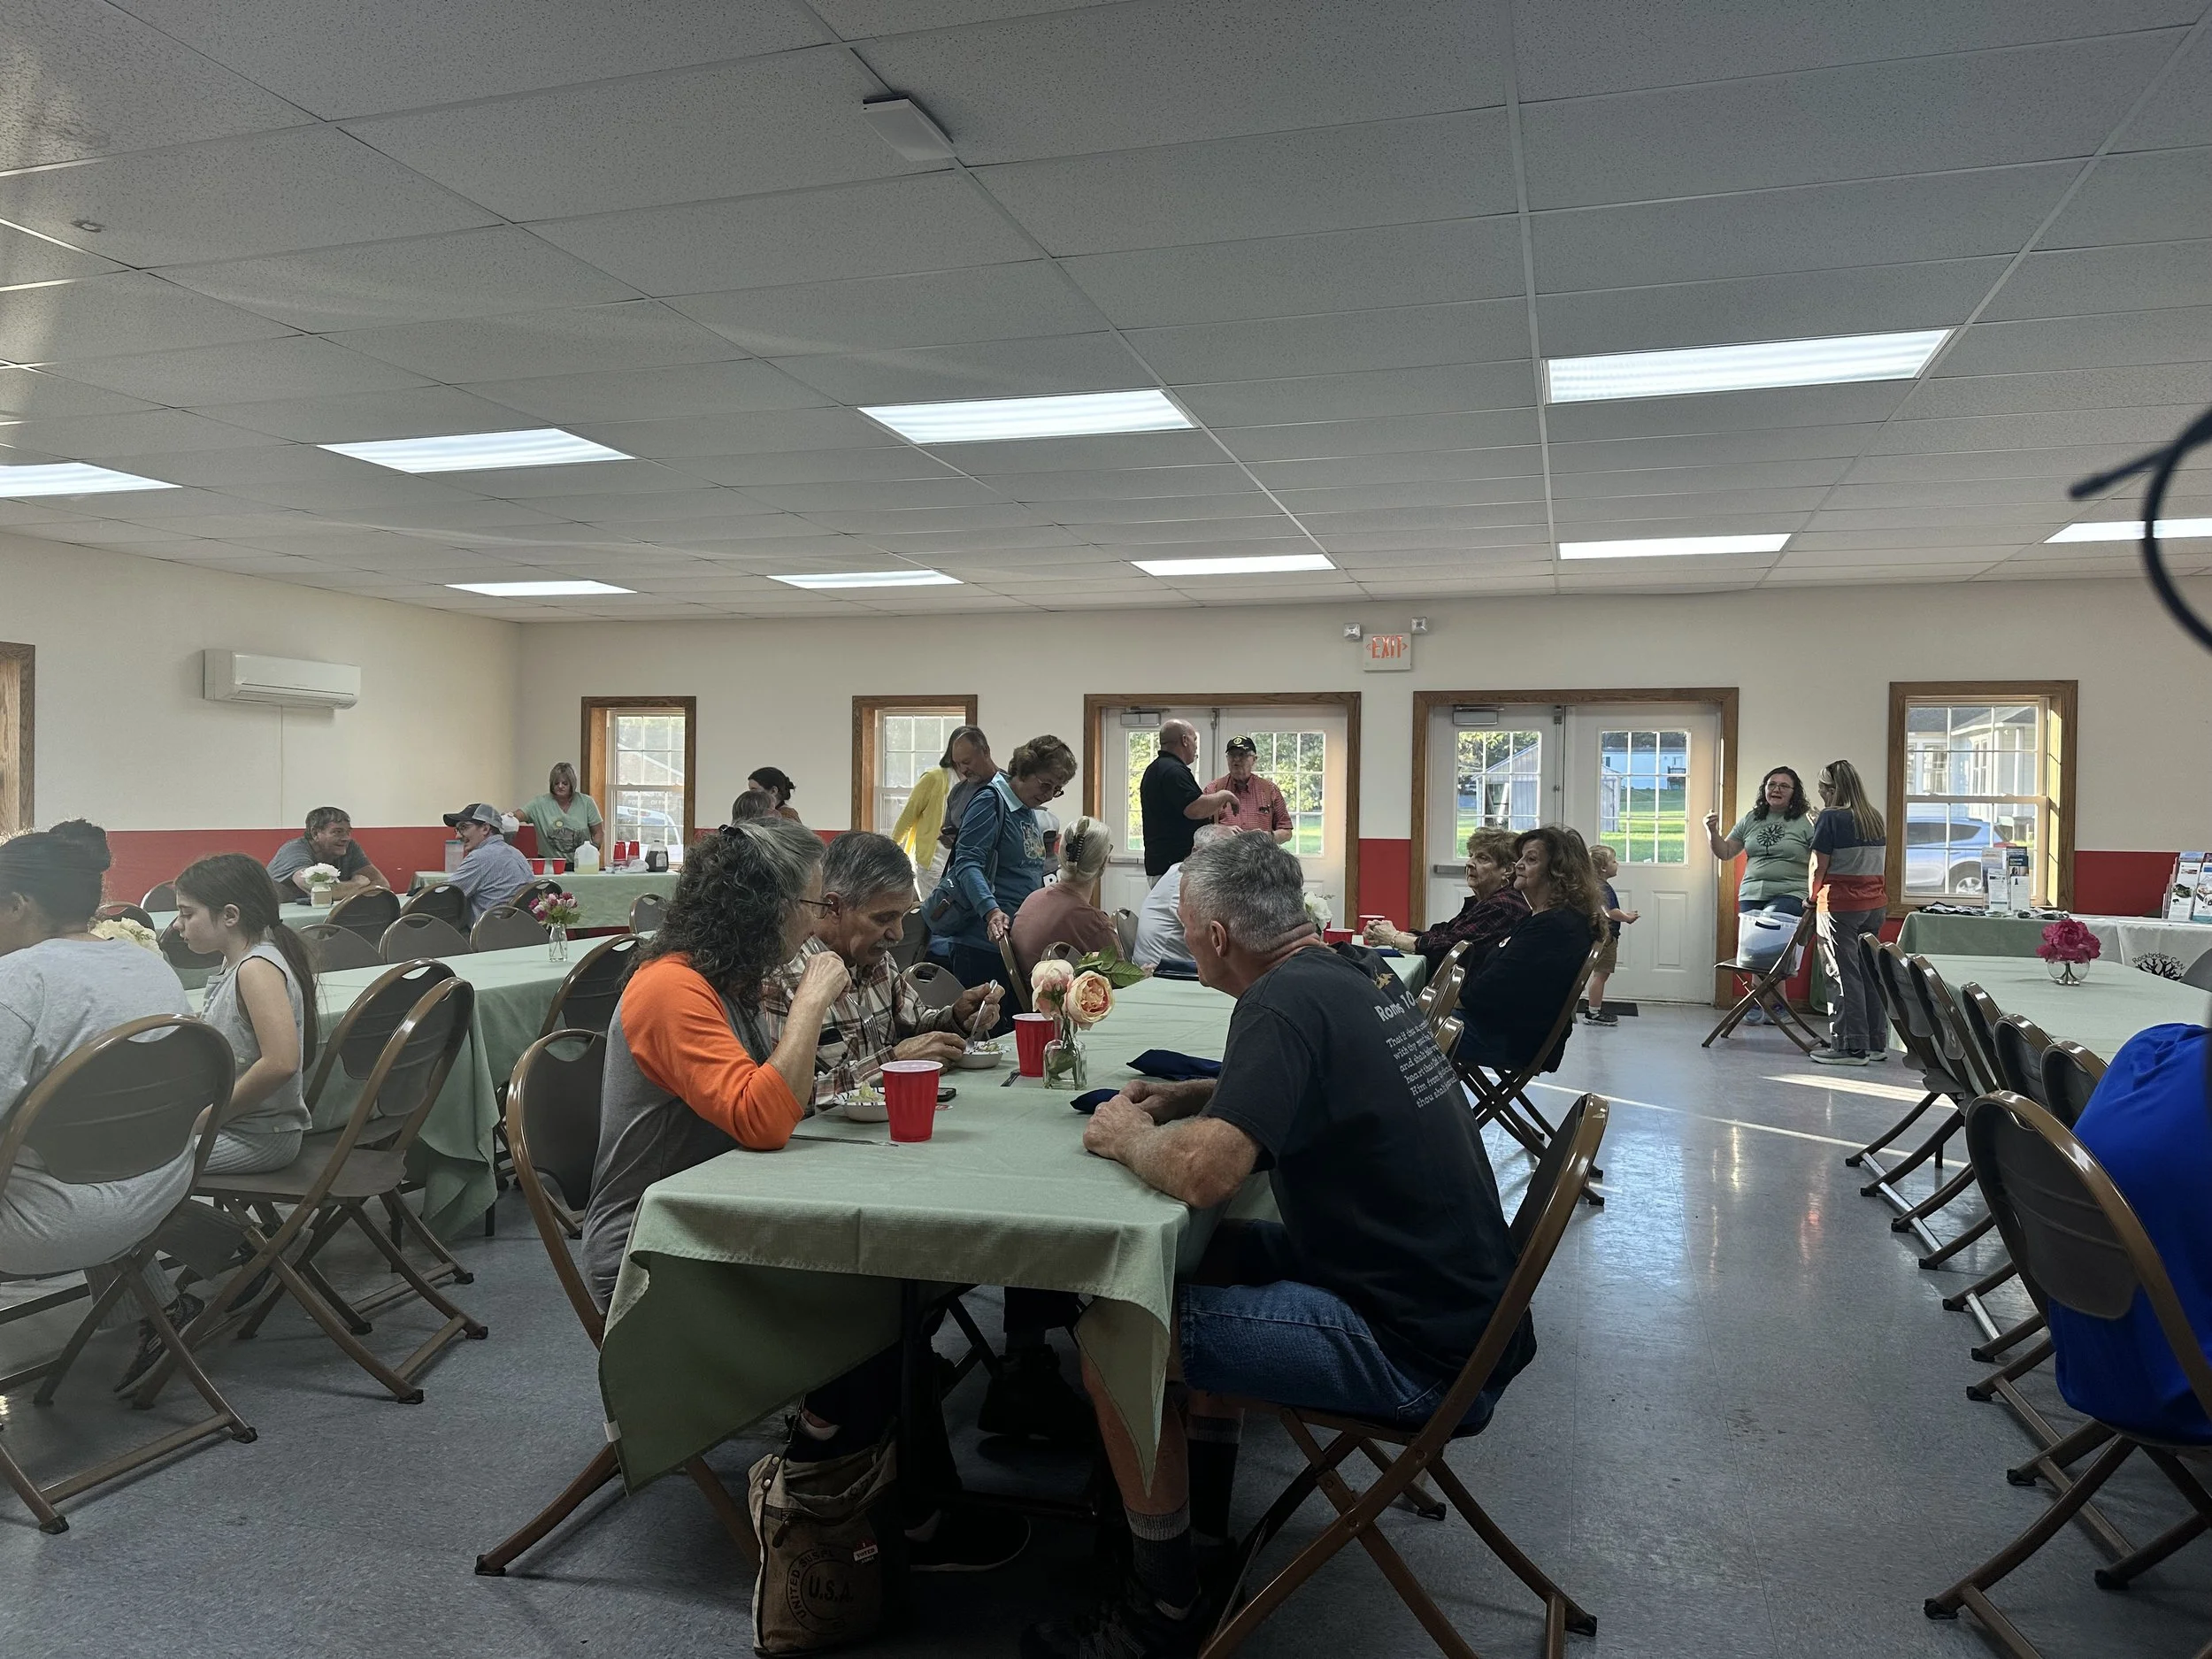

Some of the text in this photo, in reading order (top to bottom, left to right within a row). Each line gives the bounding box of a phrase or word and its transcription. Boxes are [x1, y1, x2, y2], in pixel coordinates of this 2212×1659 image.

[1371, 635, 1404, 659] EXIT
[2131, 952, 2185, 971] Rockbridge CAN
[1386, 1034, 1403, 1048] That
[1393, 1046, 1410, 1060] with
[1400, 1057, 1415, 1072] and
[1403, 1067, 1425, 1085] heart
[1409, 1083, 1428, 1096] Him
[1416, 1094, 1434, 1108] thou
[856, 1548, 875, 1558] VOTED
[789, 1570, 808, 1619] UNITED
